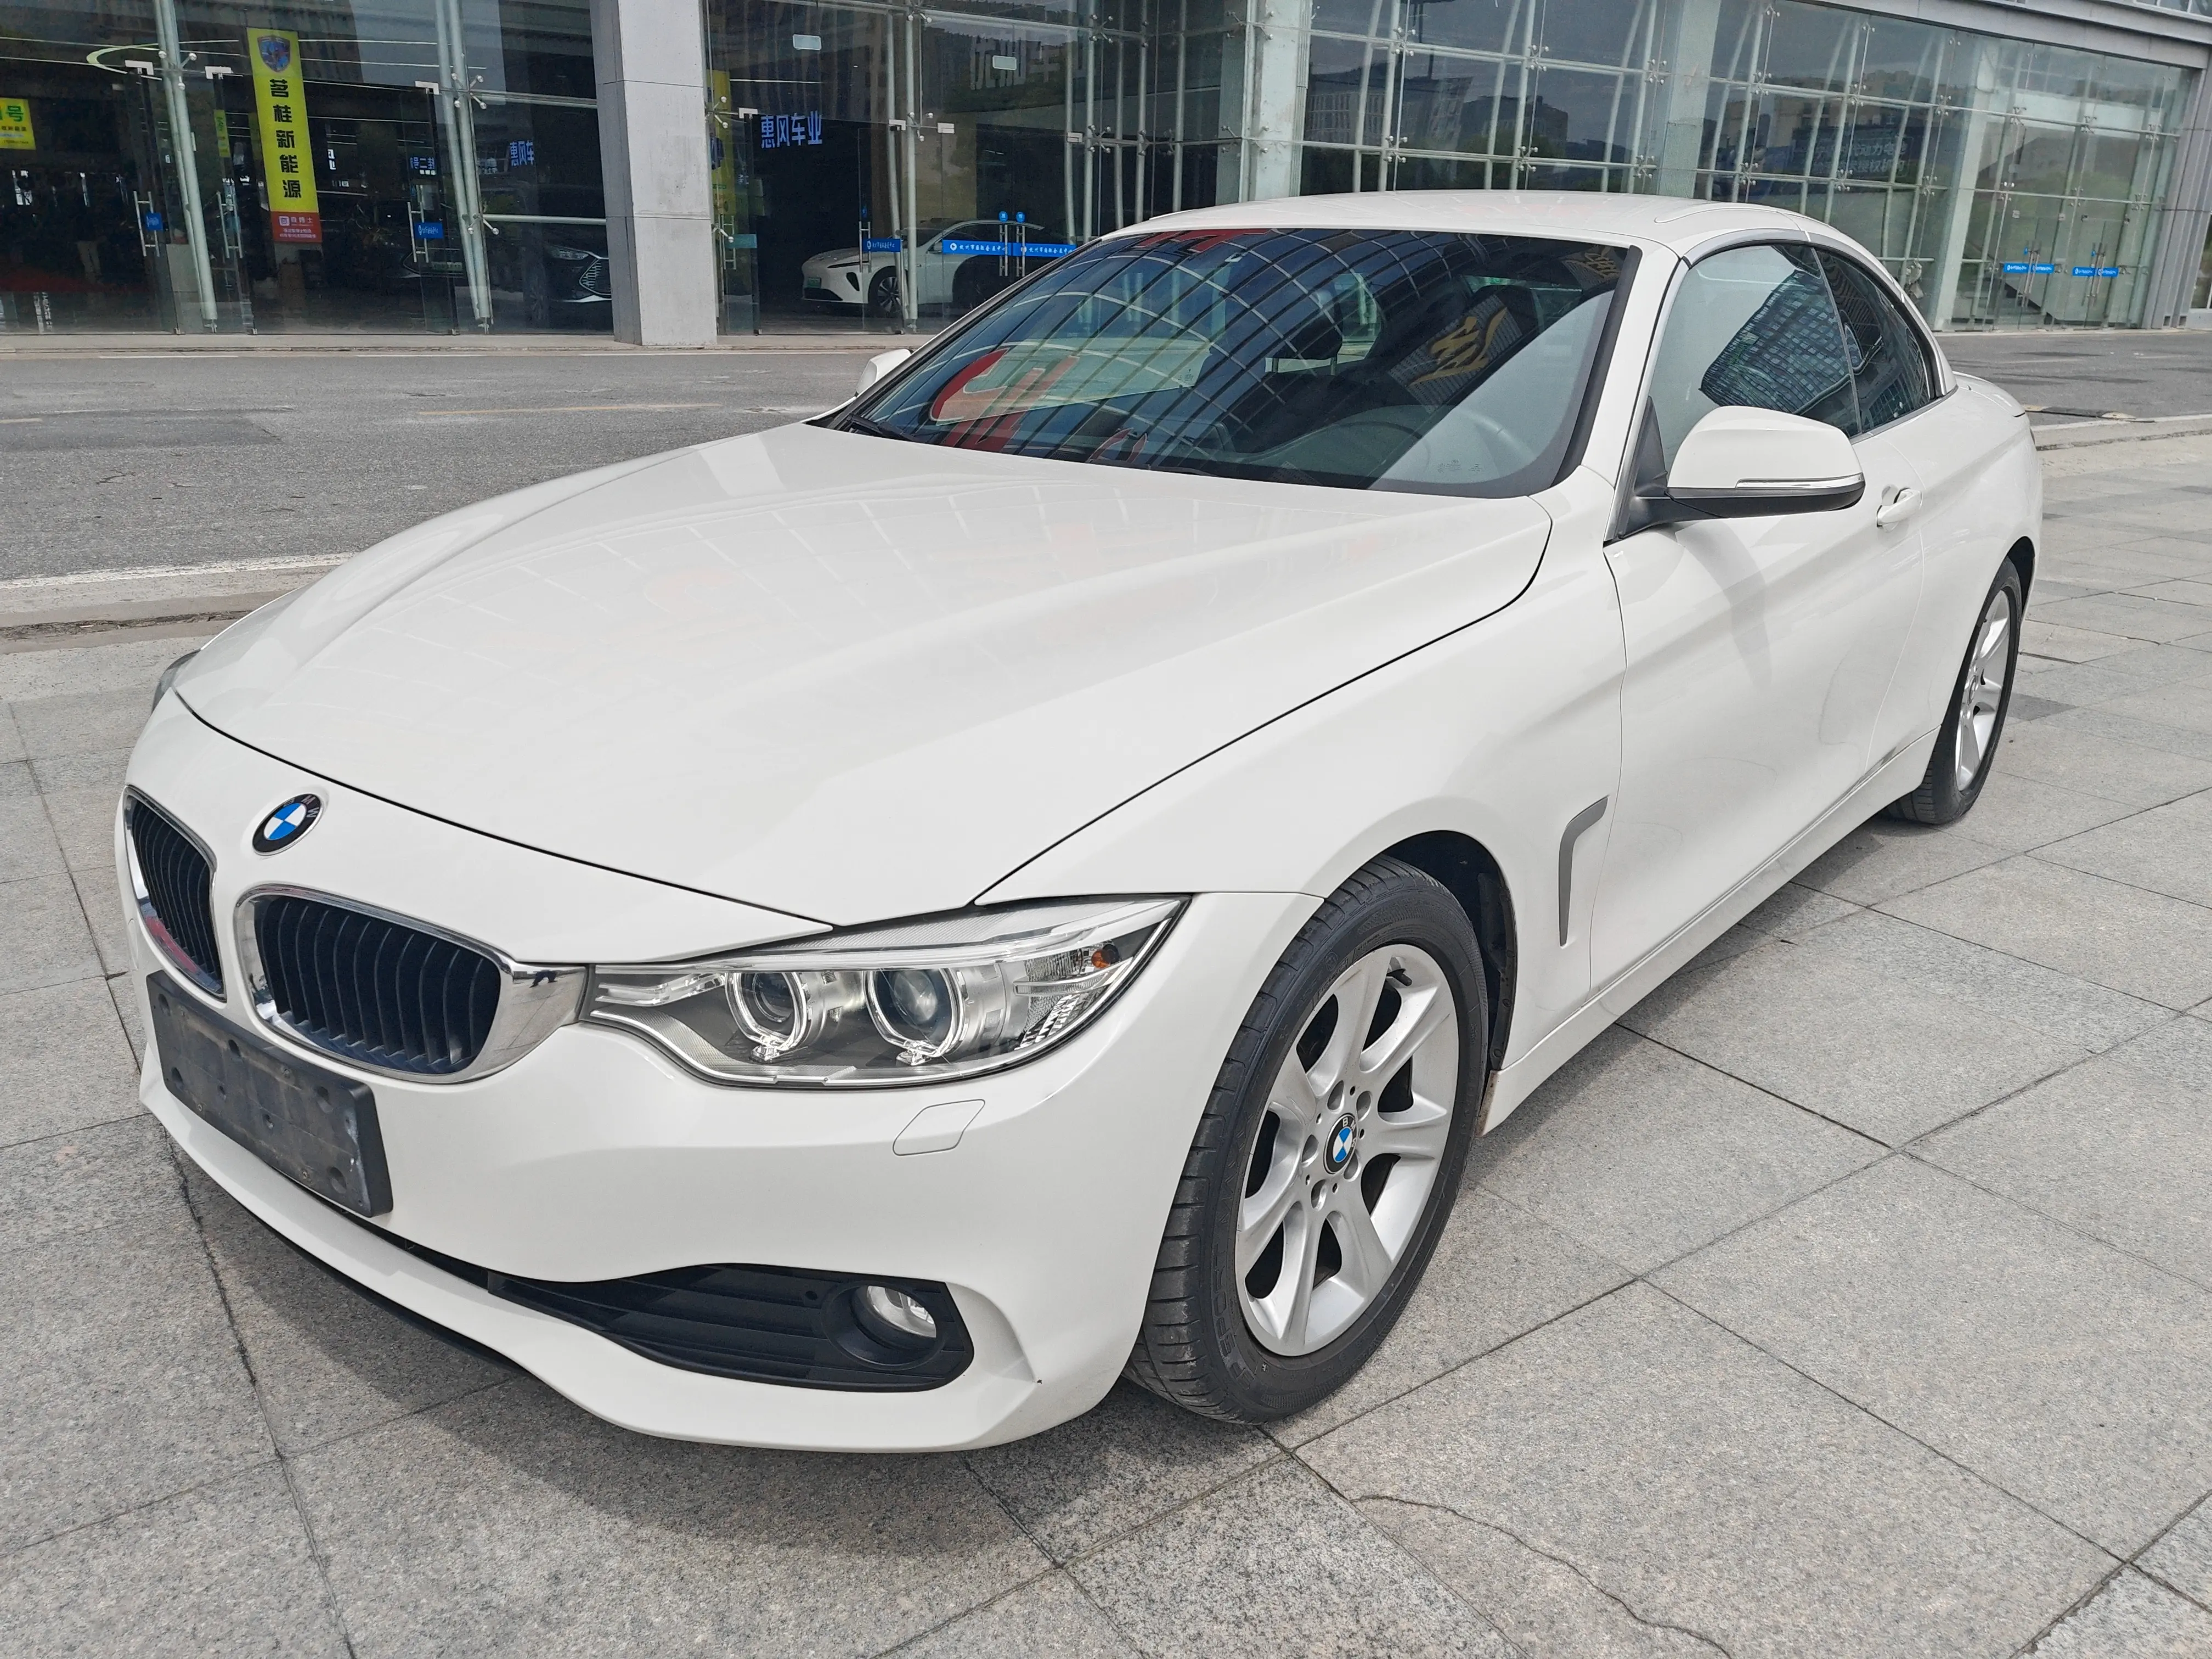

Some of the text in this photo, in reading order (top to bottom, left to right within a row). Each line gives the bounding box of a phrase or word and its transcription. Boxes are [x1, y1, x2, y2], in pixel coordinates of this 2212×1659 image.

[760, 110, 822, 149] 惠风车业
[283, 795, 319, 818] BMW
[1342, 1117, 1356, 1148] BMW
